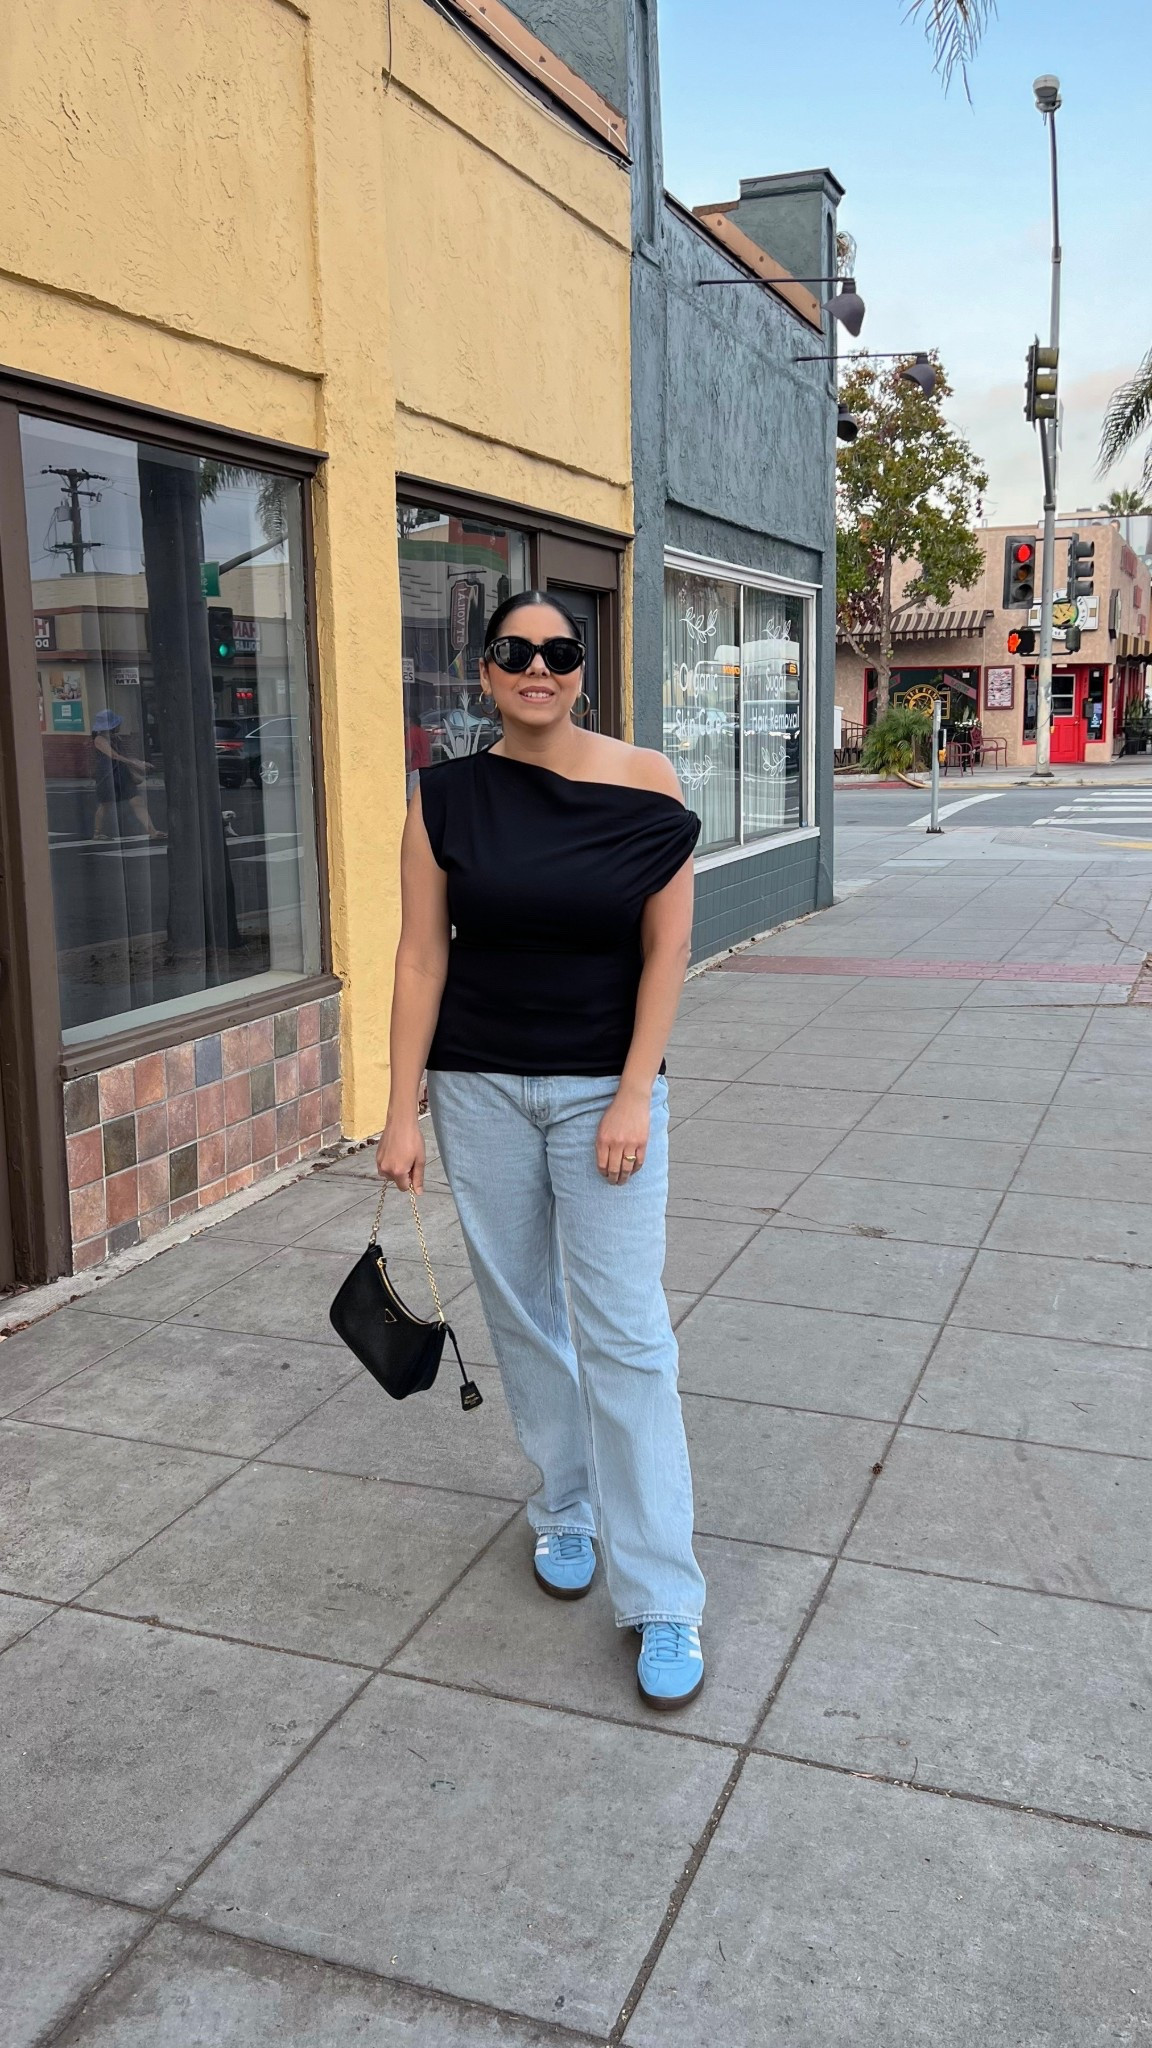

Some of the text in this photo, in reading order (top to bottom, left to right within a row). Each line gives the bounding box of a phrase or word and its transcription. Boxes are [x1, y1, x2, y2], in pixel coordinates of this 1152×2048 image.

[679, 662, 719, 699] Oganic
[765, 667, 787, 698] Sugar
[675, 708, 696, 737] Skin
[751, 705, 800, 732] Hair Removal
